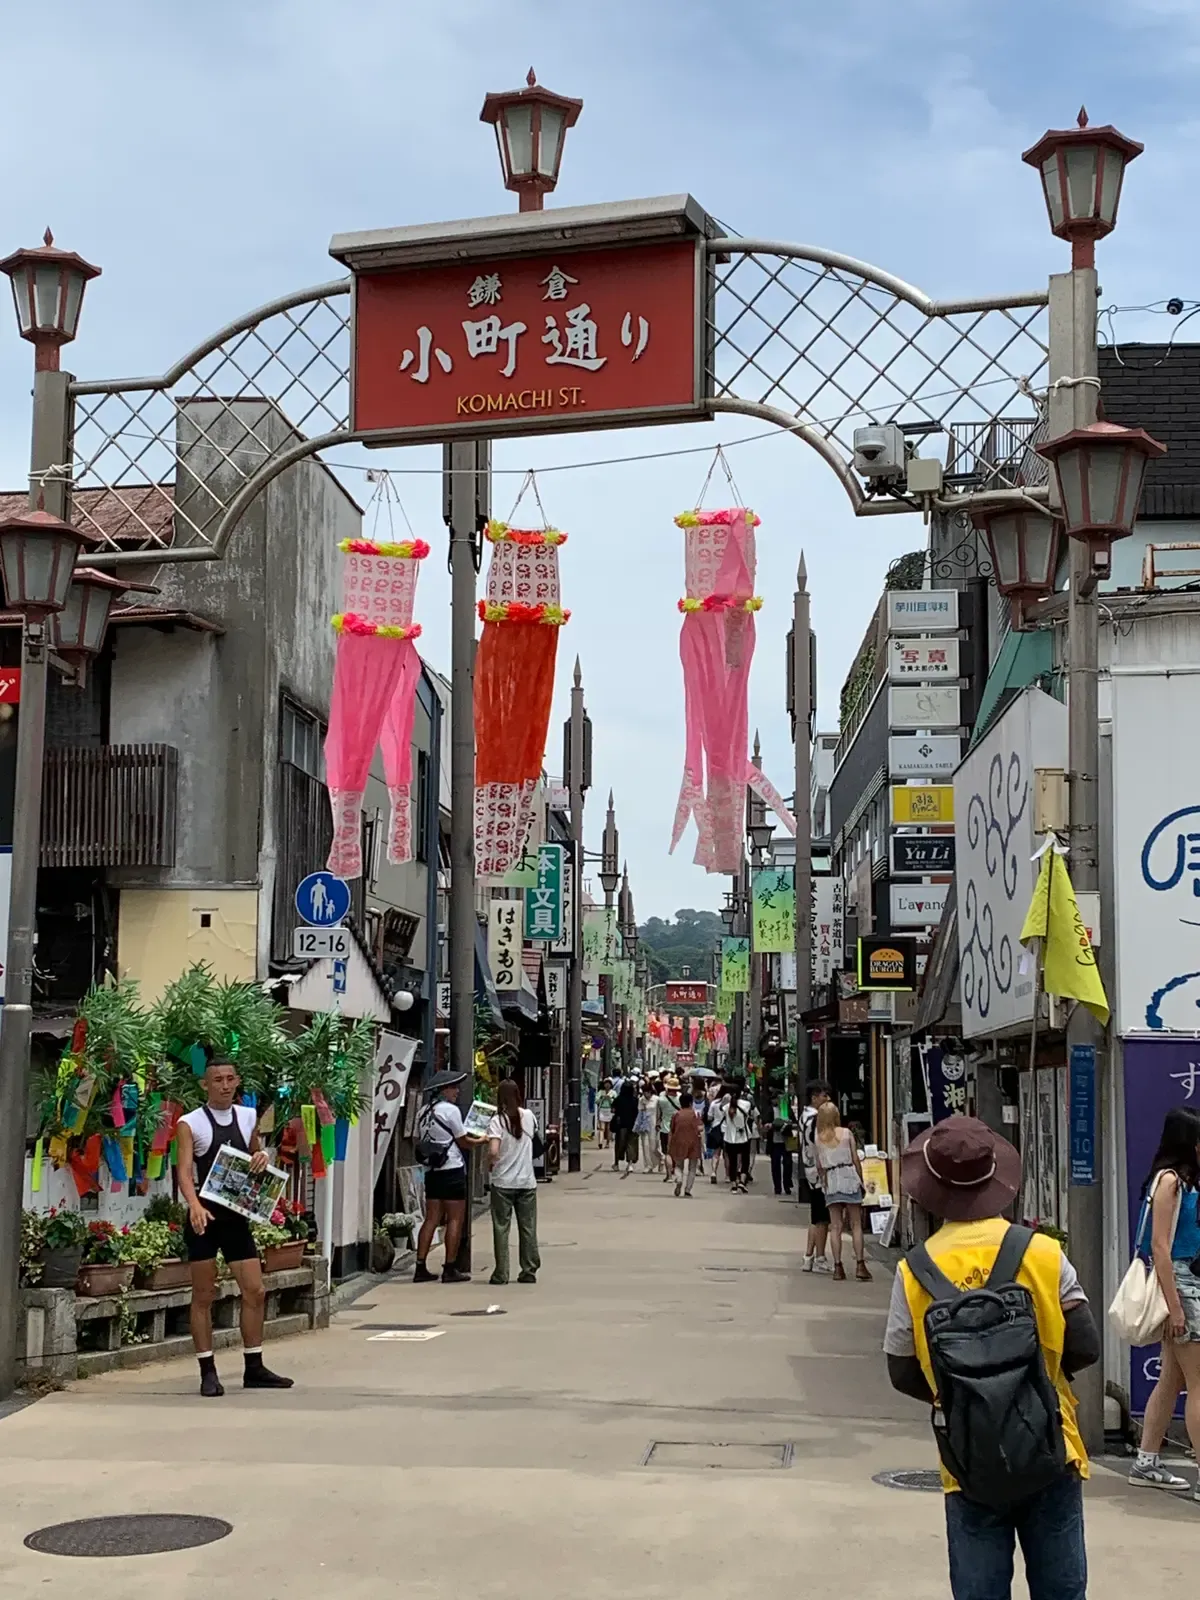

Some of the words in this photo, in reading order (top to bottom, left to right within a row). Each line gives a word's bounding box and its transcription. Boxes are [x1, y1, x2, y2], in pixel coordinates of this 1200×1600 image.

[467, 266, 579, 307] 鎌倉
[398, 303, 649, 384] 小町通り
[457, 388, 552, 415] KOMACHI
[559, 387, 587, 406] ST.
[900, 649, 947, 664] 写真
[905, 846, 927, 860] Yu
[930, 846, 950, 860] Li
[530, 849, 557, 935] 本・文具
[299, 934, 346, 952] 12-16
[496, 907, 516, 985] はきもの
